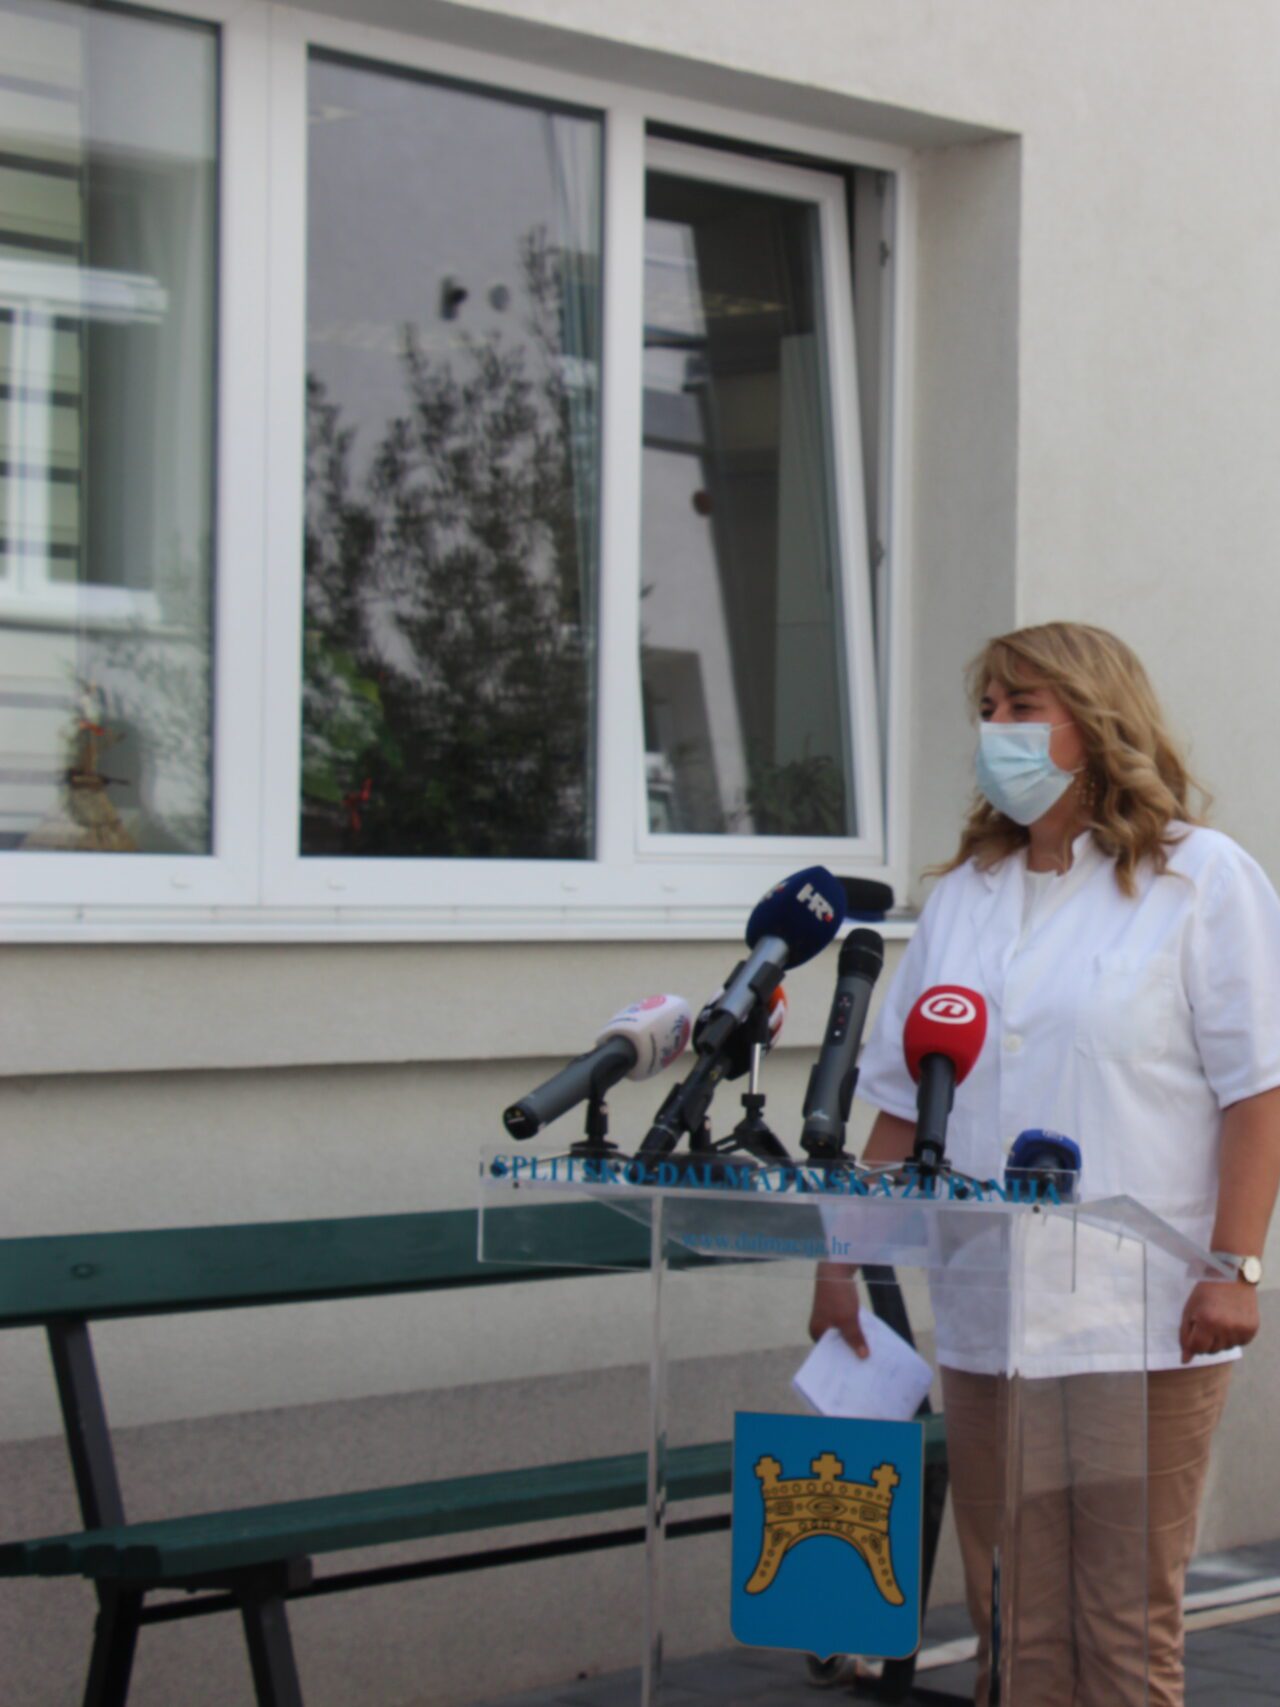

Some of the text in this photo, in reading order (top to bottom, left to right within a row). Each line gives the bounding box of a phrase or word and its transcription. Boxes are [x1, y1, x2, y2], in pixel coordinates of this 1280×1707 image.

[491, 1154, 1062, 1206] SPLITSKO-DALMATINSKA ŽUPANIJA
[682, 1231, 852, 1258] www.dalmacija.hr
